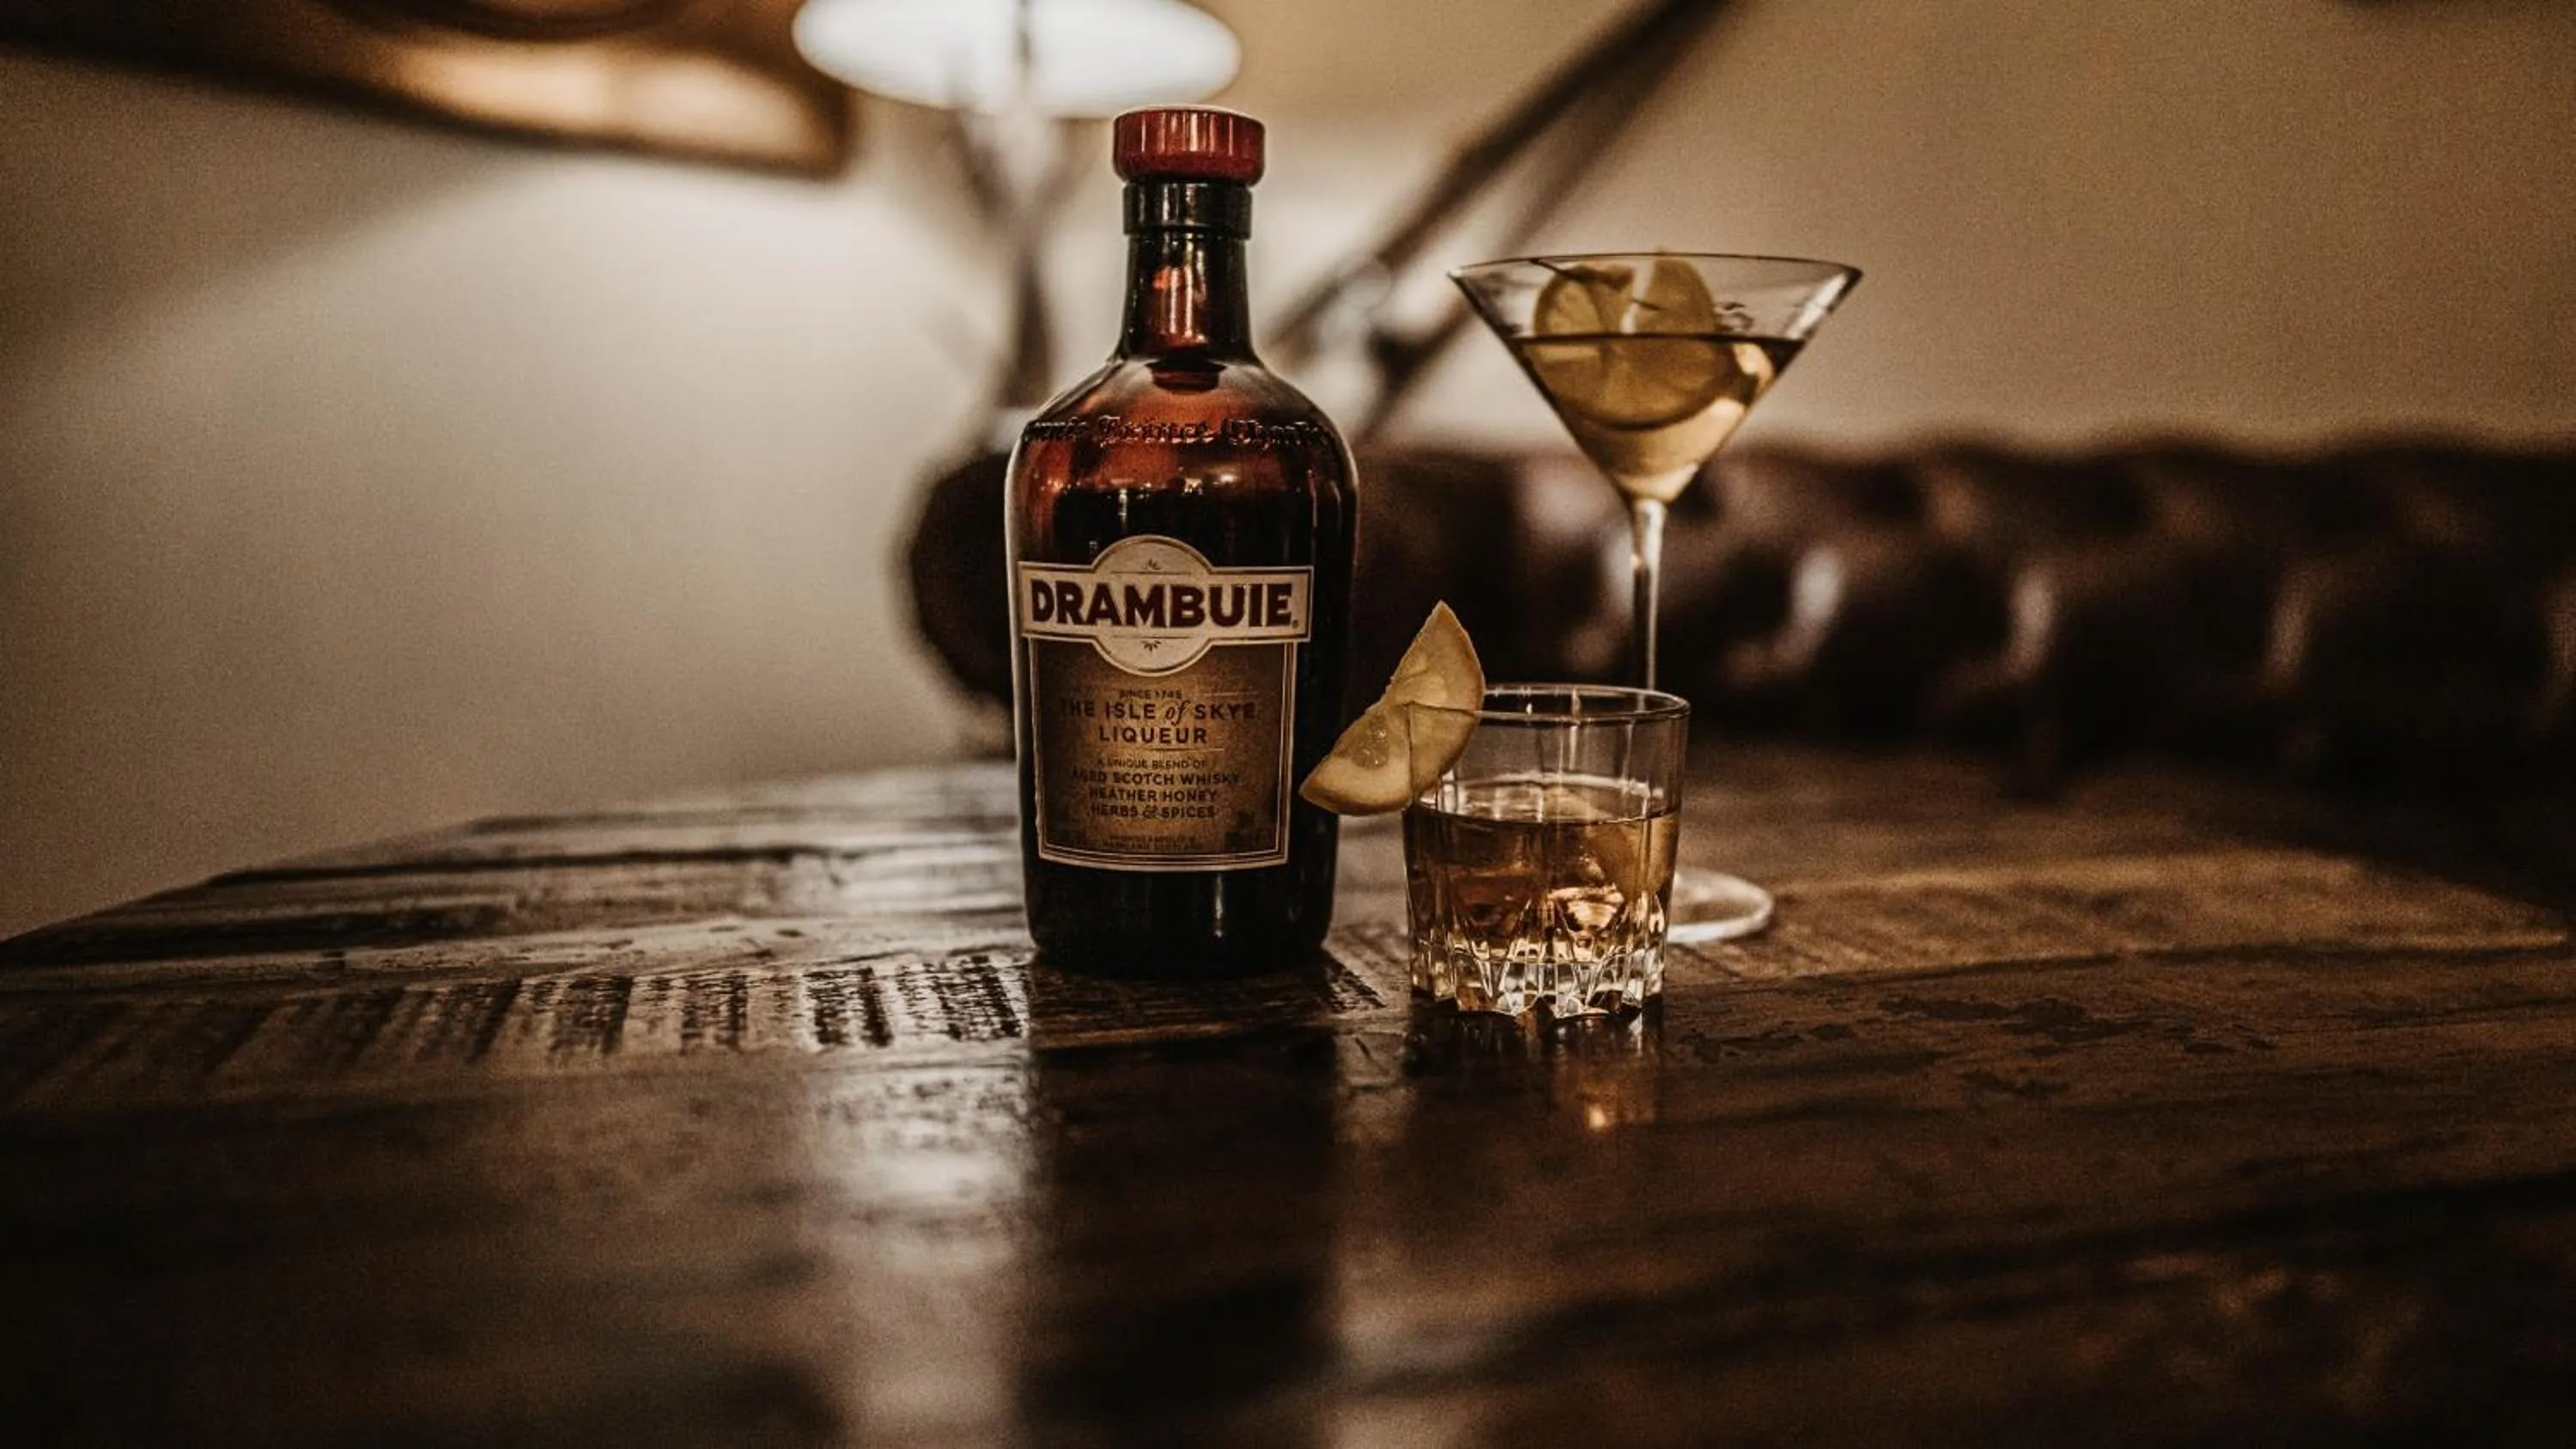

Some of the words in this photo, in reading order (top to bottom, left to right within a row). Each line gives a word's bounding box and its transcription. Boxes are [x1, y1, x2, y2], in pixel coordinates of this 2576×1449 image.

[1031, 579, 1292, 628] DRAMBUIE
[1061, 698, 1095, 718] THE
[1105, 701, 1156, 719] ISLE
[1164, 700, 1190, 725] of
[1194, 702, 1256, 720] SKYE
[1099, 725, 1207, 744] LIQUEUR
[1151, 759, 1188, 770] BLEND
[1113, 771, 1174, 785] SCOTCH
[1180, 771, 1240, 785] WHISKY
[1089, 787, 1157, 802] HEATHER
[1163, 789, 1218, 803] HONEY
[1091, 803, 1138, 818] HERBS
[1161, 805, 1215, 819] SPICES
